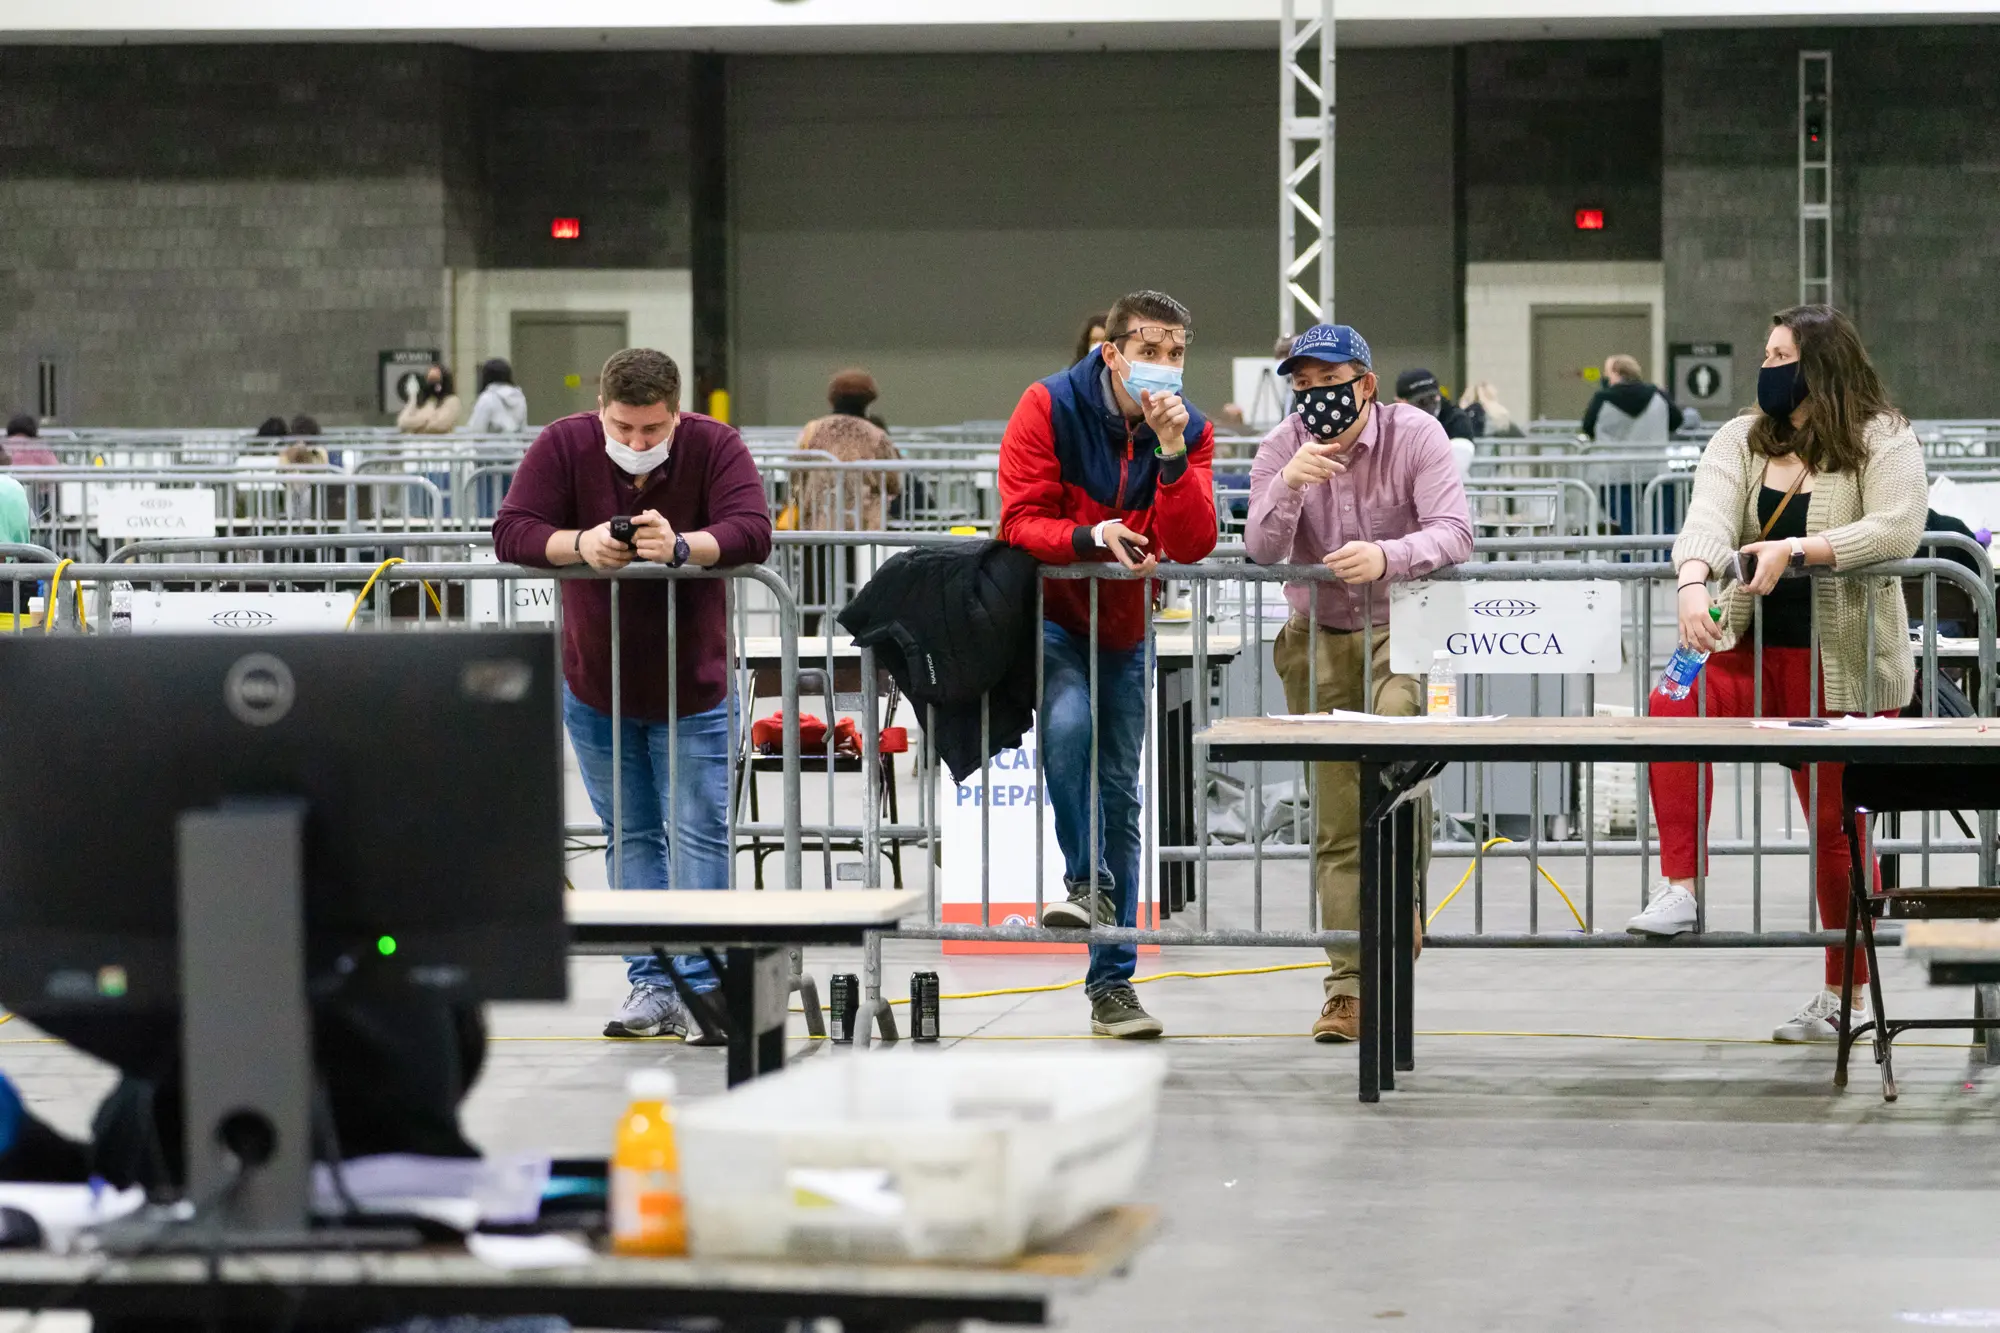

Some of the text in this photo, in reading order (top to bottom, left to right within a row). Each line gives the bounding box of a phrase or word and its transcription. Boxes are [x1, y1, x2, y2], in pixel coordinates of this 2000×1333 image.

[126, 515, 186, 529] GWCCA
[1446, 632, 1564, 655] GWCCA
[926, 653, 937, 685] NAUTICA
